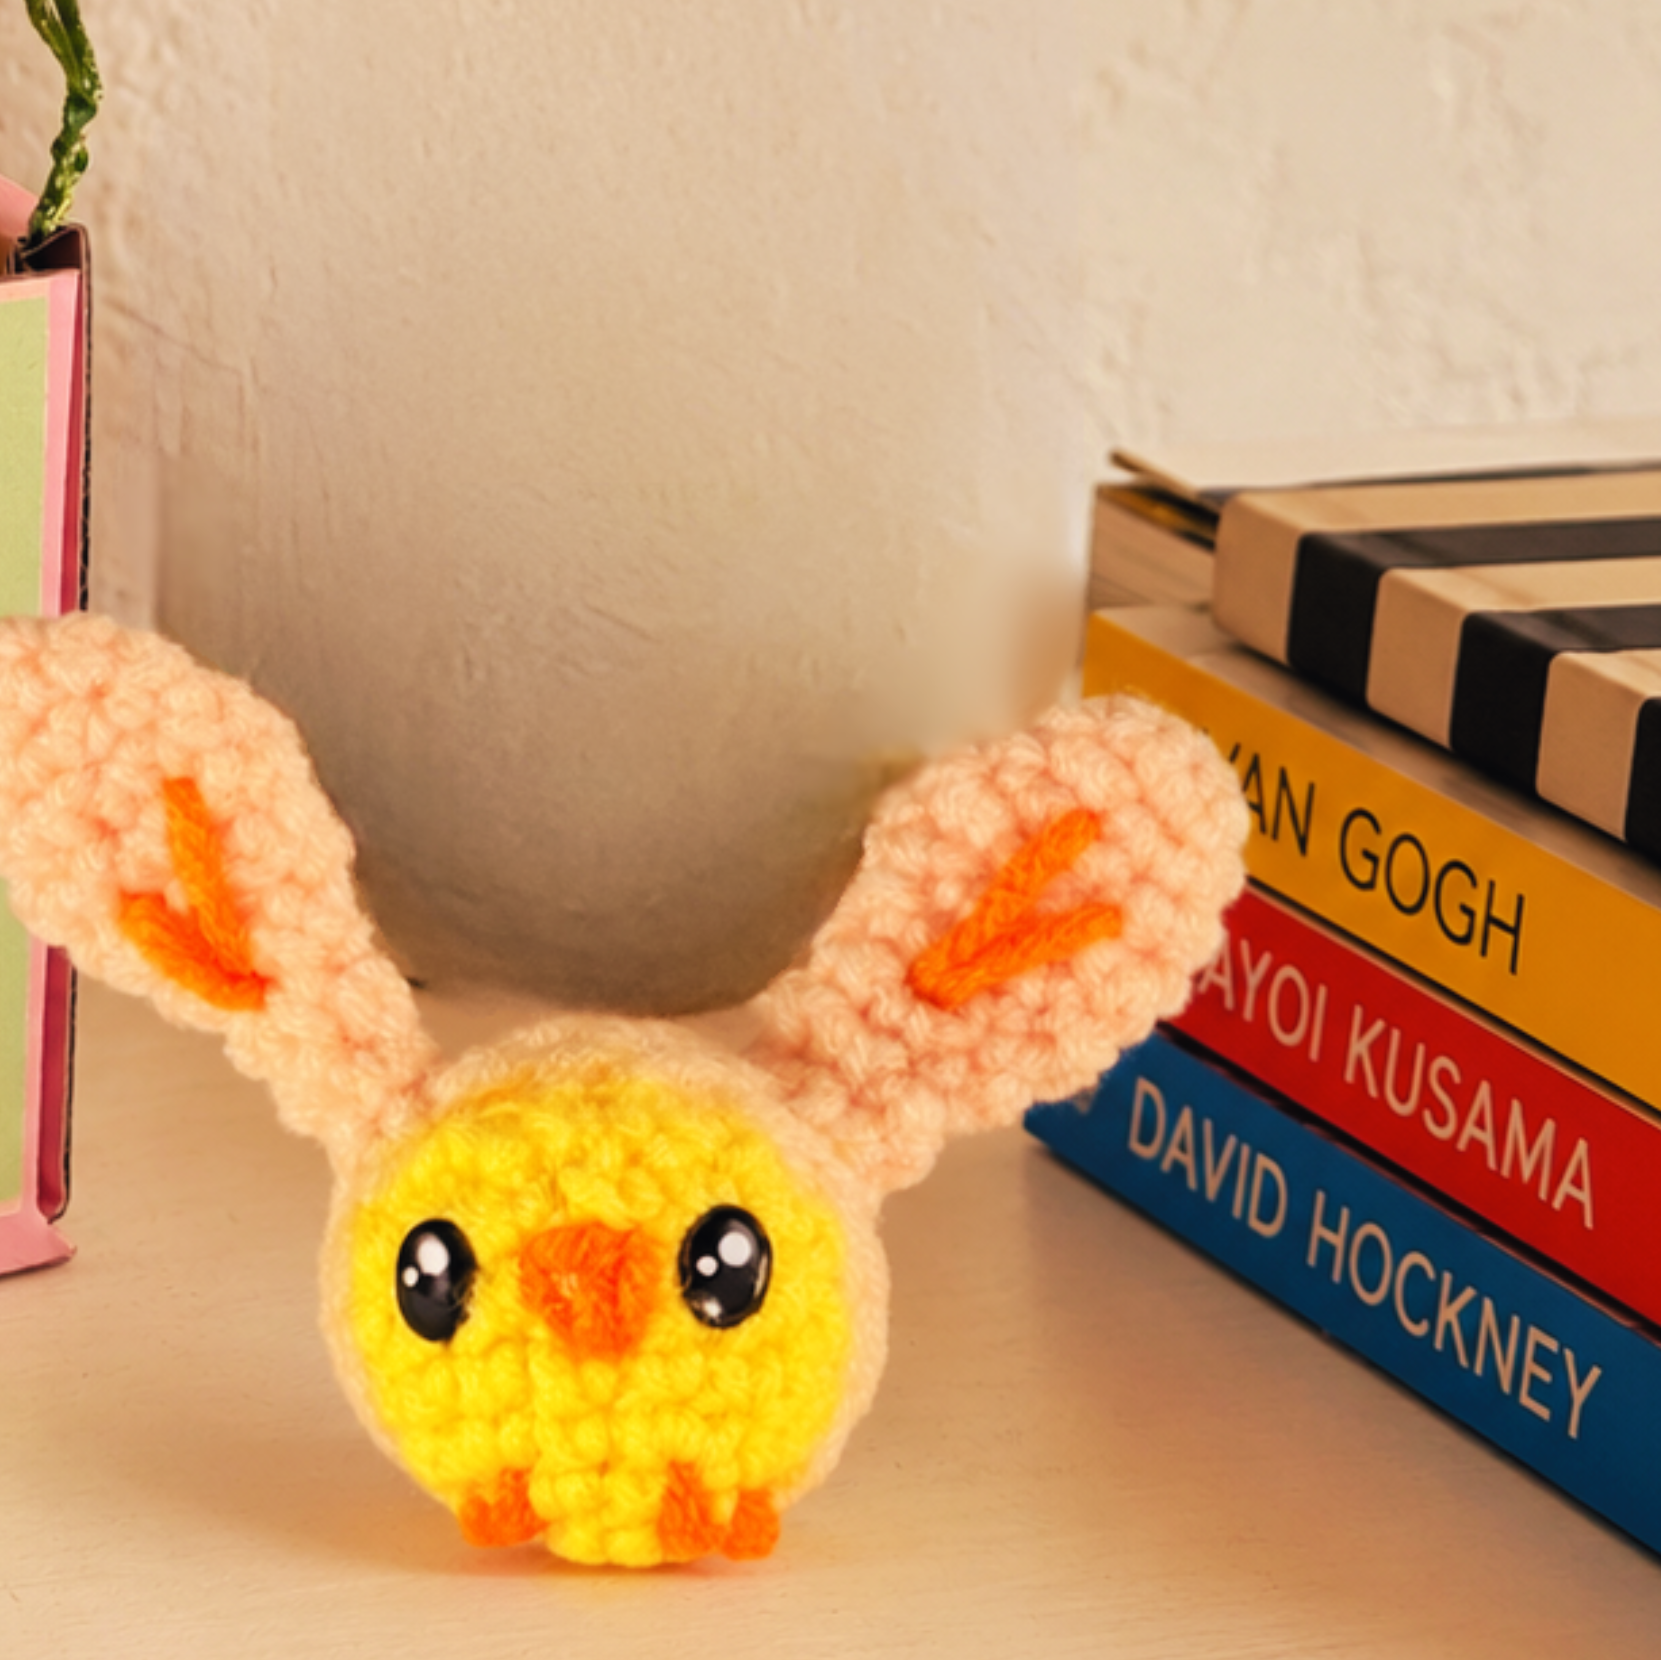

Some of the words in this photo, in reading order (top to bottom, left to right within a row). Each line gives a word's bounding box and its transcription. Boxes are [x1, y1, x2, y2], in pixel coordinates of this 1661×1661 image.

[1338, 807, 1528, 976] GOGH
[1197, 933, 1327, 1067] AYOI
[1343, 1003, 1596, 1229] KUSAMA
[1127, 1075, 1289, 1241] DAVID
[1306, 1188, 1603, 1440] HOCKNEY
